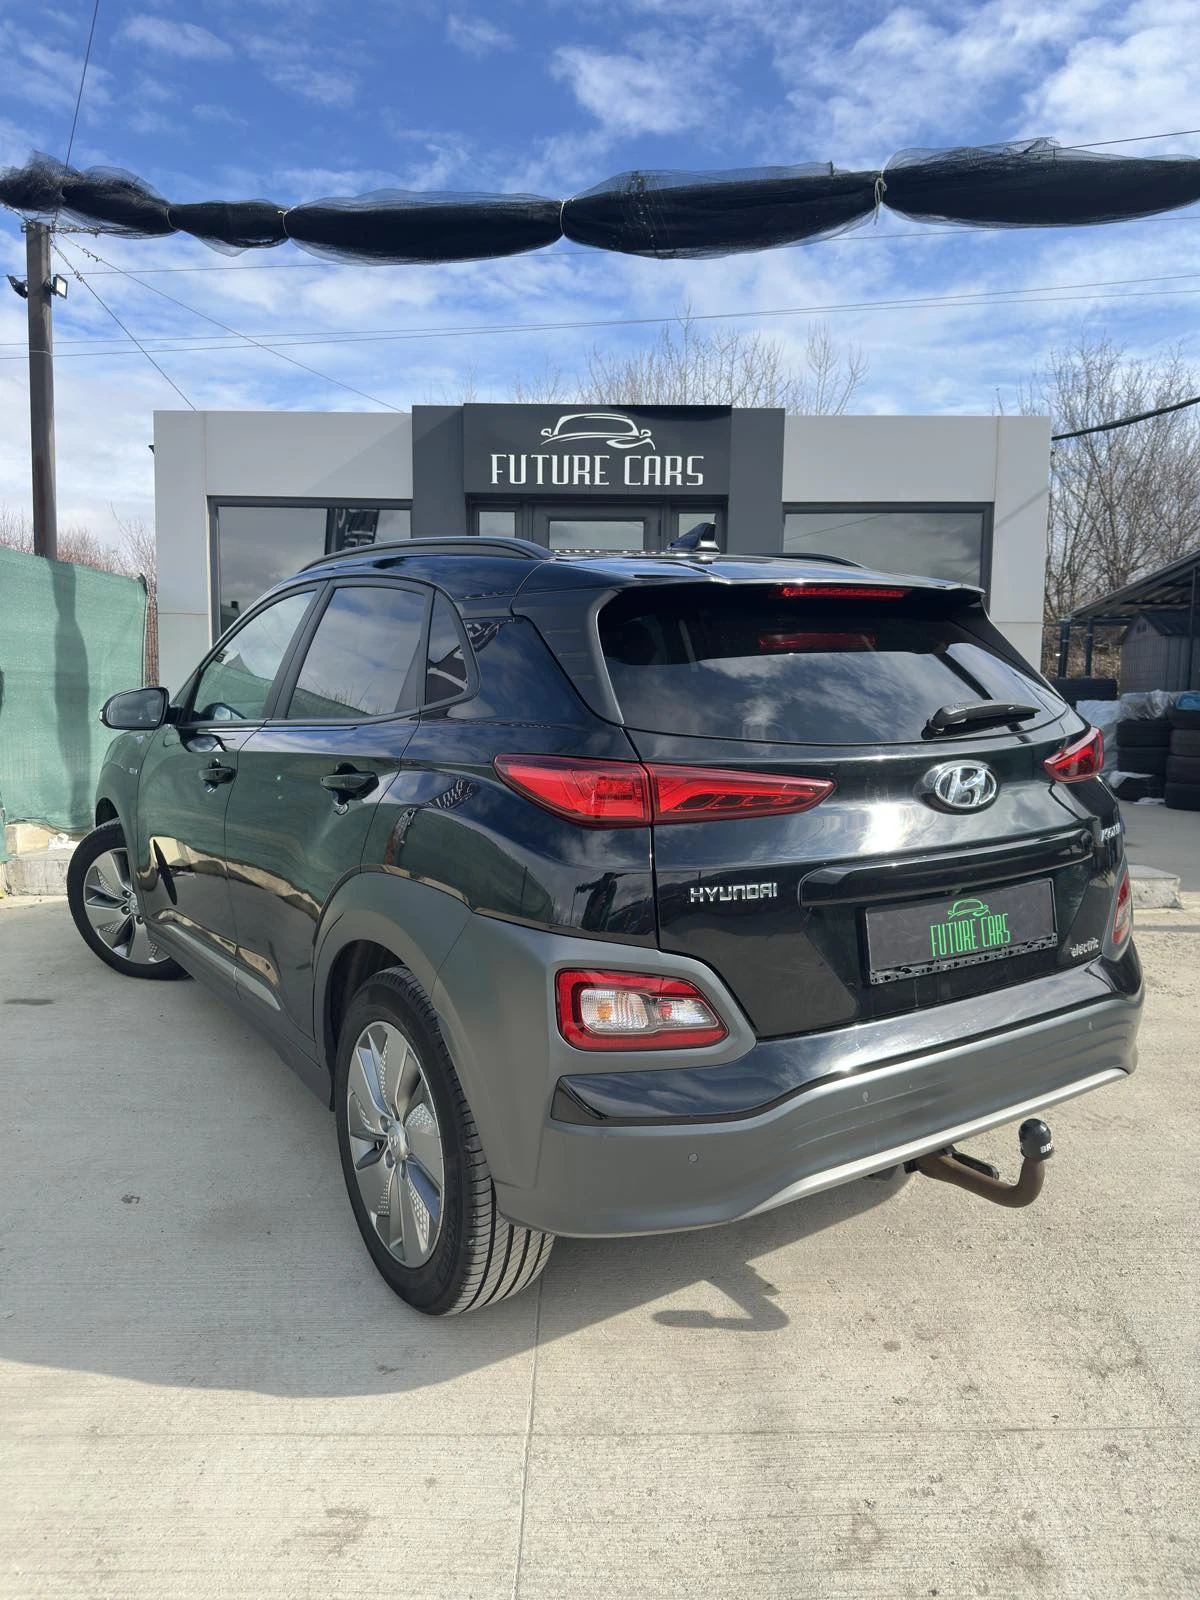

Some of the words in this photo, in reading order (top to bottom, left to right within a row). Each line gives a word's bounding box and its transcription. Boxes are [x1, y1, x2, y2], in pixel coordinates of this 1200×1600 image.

[490, 454, 610, 485] FUTURE
[624, 455, 705, 486] CARS
[690, 883, 777, 902] HYUNDAI
[930, 918, 979, 957] FUTURE
[980, 913, 1011, 947] CARS
